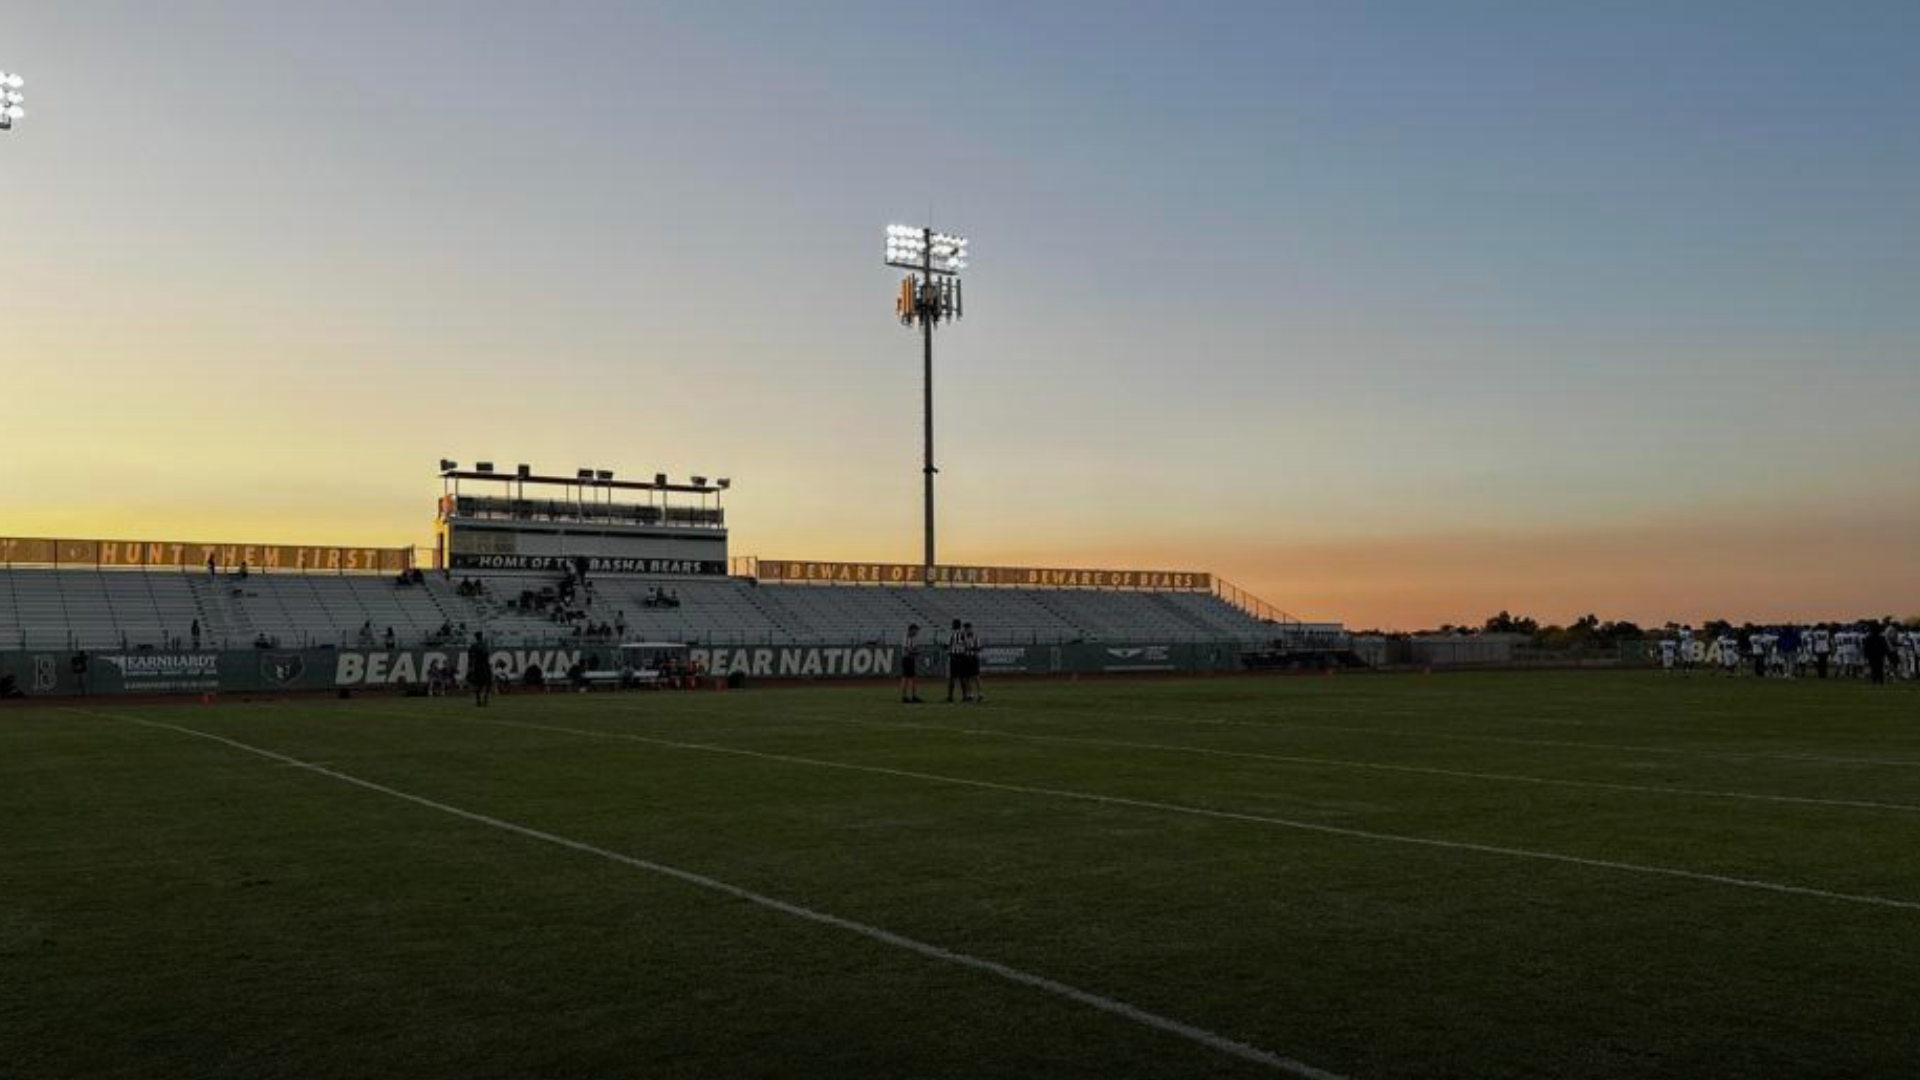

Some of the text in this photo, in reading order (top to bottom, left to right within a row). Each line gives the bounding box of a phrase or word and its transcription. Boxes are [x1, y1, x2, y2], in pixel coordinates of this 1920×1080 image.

[102, 542, 377, 569] HUNT THEM FIRST
[479, 555, 527, 568] HOME
[531, 557, 552, 569] OF
[589, 558, 644, 571] BASHA
[650, 560, 702, 573] BEARS
[790, 564, 990, 583] BEWARE OF BEARS
[1029, 570, 1193, 587] BEWARE OF BEARS
[128, 656, 217, 670] EARNHARDT
[689, 647, 894, 676] BEAR NATION
